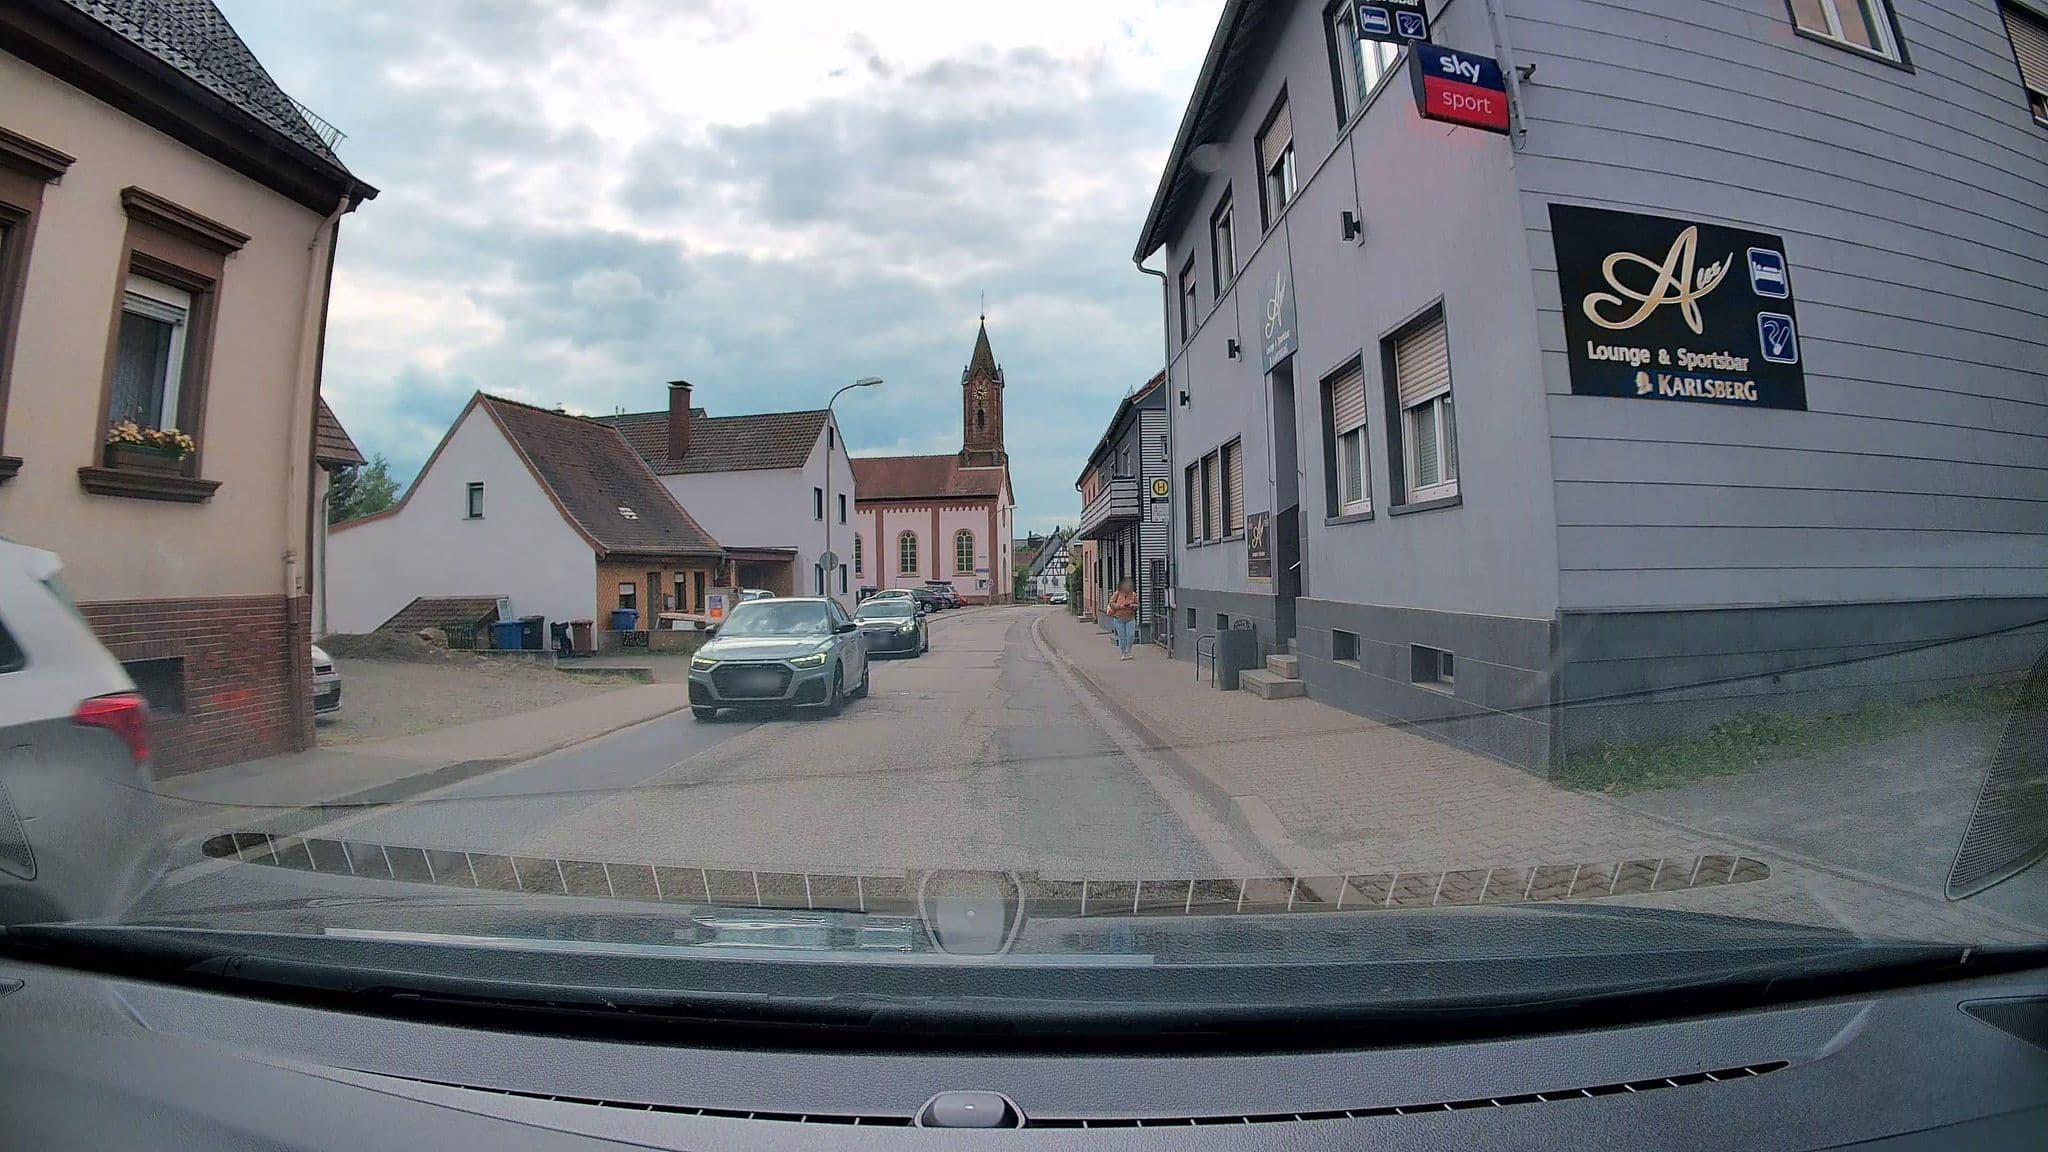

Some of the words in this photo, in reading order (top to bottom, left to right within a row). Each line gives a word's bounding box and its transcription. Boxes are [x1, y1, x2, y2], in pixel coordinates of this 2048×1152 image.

[1439, 54, 1480, 83] sky
[1442, 91, 1492, 114] sport
[1587, 340, 1651, 367] Lounge
[1658, 348, 1671, 365] &
[1677, 348, 1749, 372] Sportsbar
[1658, 374, 1758, 401] KARLSBERG
